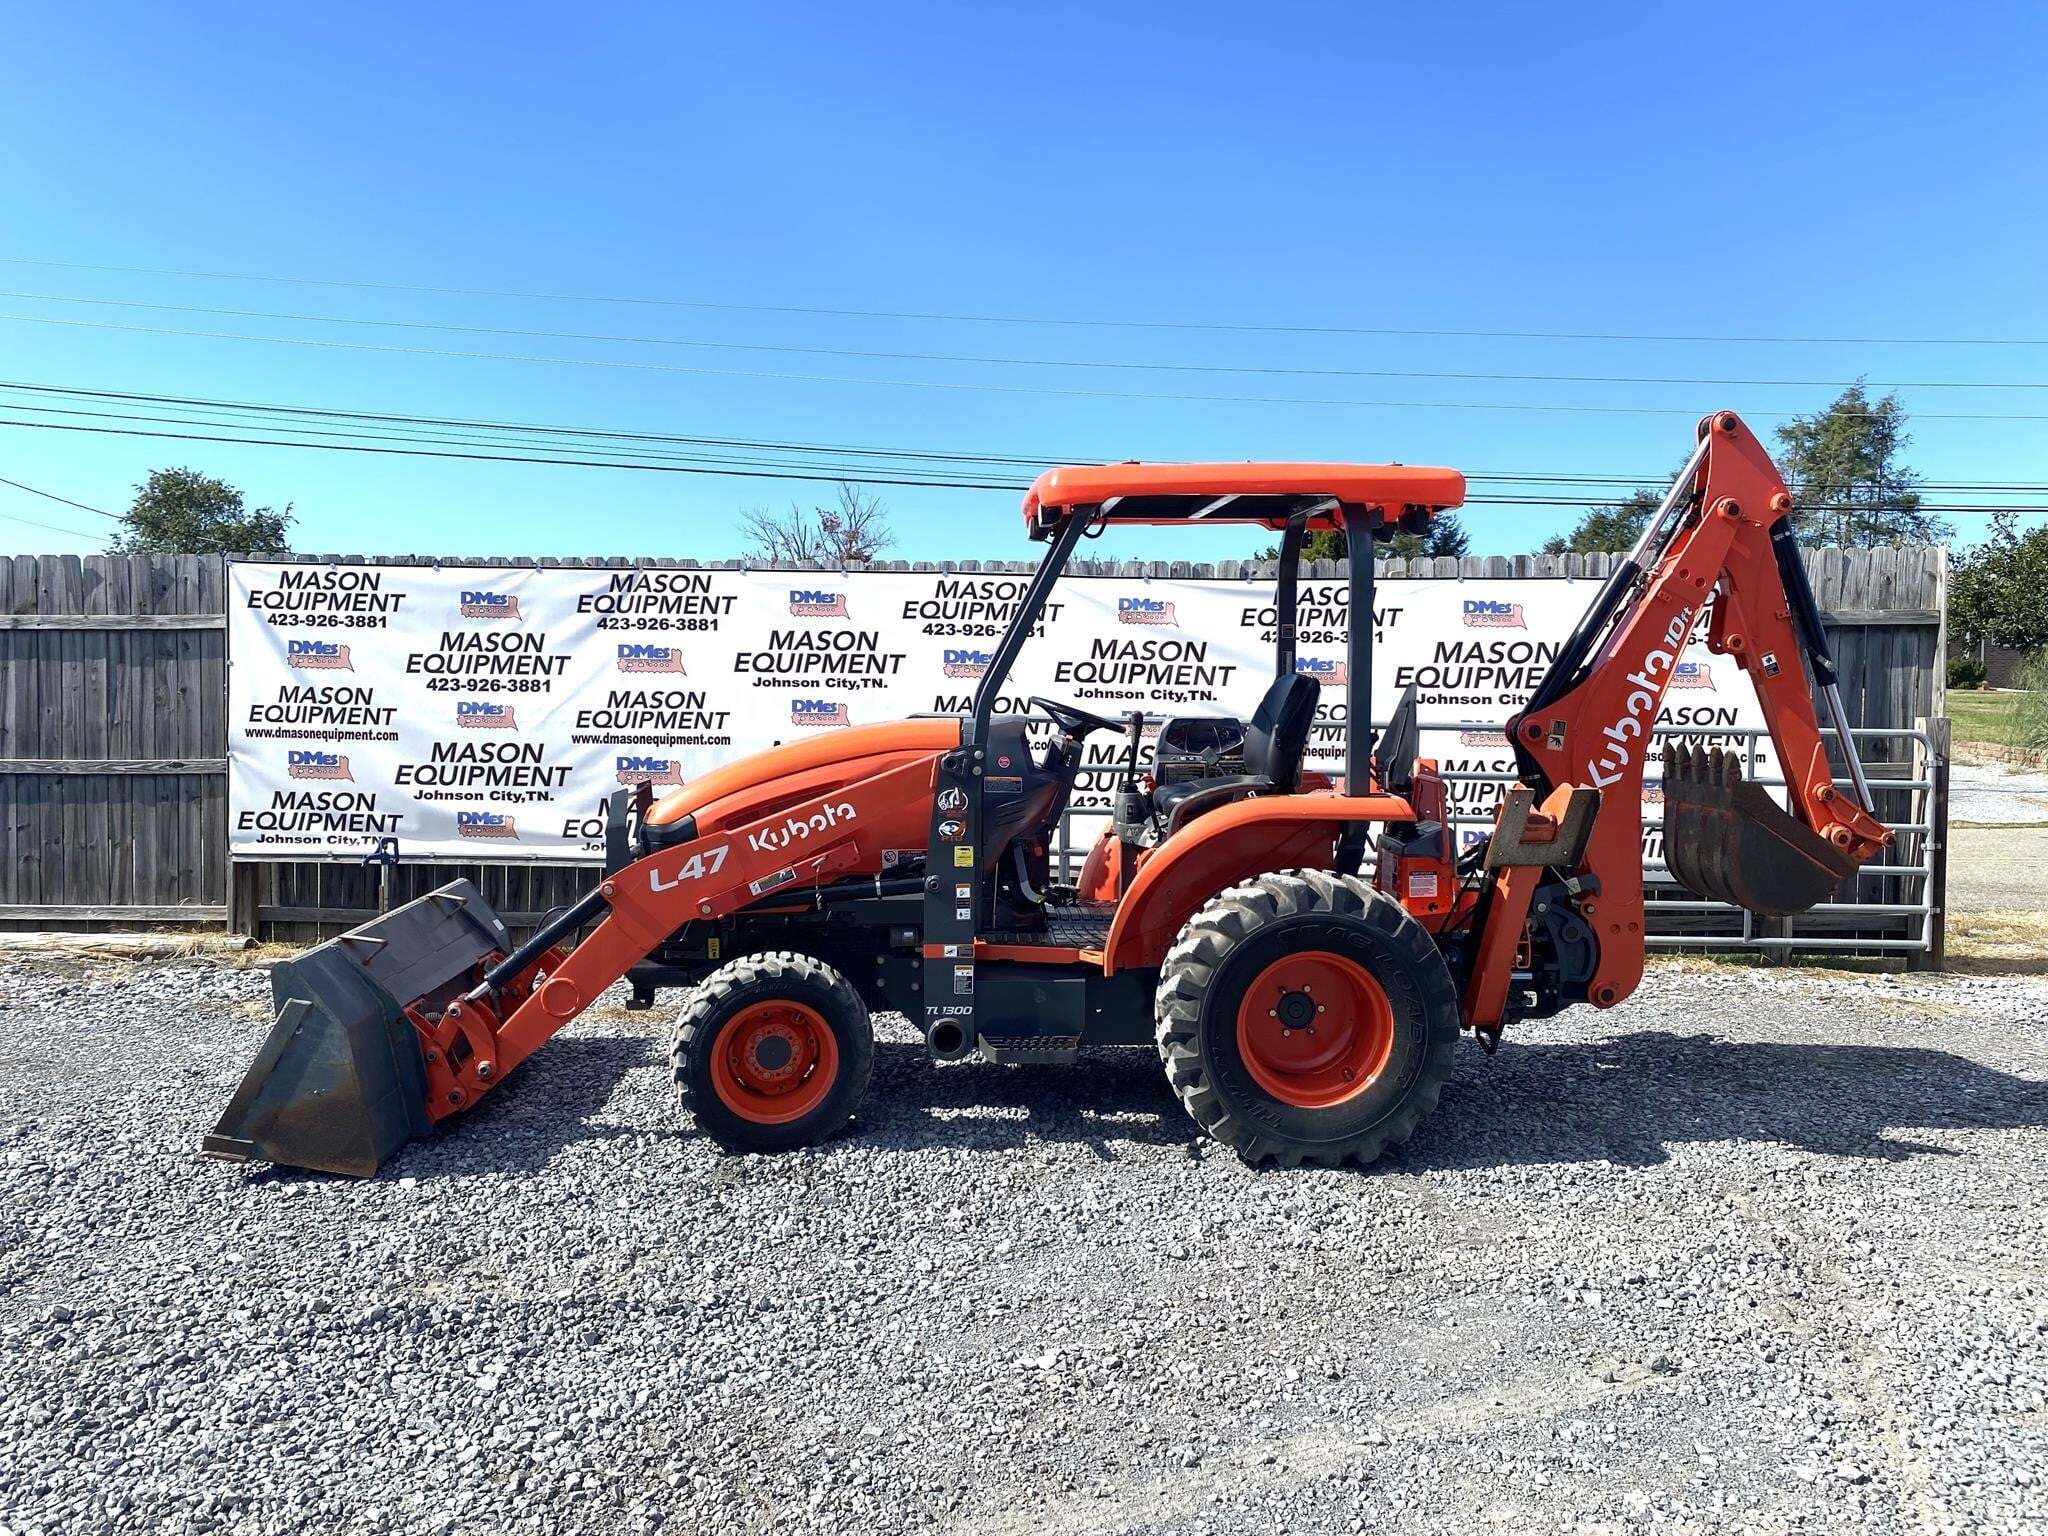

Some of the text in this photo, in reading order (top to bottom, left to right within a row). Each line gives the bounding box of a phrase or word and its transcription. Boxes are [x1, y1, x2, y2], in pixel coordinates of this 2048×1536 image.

[279, 571, 380, 590] MASON
[609, 574, 711, 593] MASON
[248, 591, 406, 612] EQUIPMENT
[577, 595, 737, 614] EQUIPMENT
[268, 614, 386, 628] 423-926-3881
[597, 617, 717, 631] 423-926-3881
[440, 632, 545, 652] MASON
[769, 631, 878, 651] MASON
[1091, 639, 1207, 662] MASON
[1434, 642, 1560, 664] MASON
[406, 654, 571, 675] EQUIPMENT
[734, 653, 906, 674] EQUIPMENT
[753, 677, 819, 687] Johnson
[1055, 662, 1236, 686] EQUIPMENT
[1394, 667, 1545, 688] EQUIPME
[427, 678, 550, 692] 423-926-3881
[1074, 688, 1144, 699] Johnson
[279, 686, 373, 705] MASON
[608, 691, 705, 709] MASON
[934, 696, 1031, 714] MAON
[1416, 693, 1492, 705] Johnson
[249, 705, 397, 725] EQUIPMENT
[576, 711, 730, 729] EQUIPMENT
[1579, 649, 1674, 789] Kubota
[1655, 707, 1738, 725] ASON
[245, 727, 398, 742] www.dmasonequipment.com
[572, 733, 730, 747] www.dmasonequipment.com
[431, 742, 544, 763] MASON
[395, 765, 573, 786] EQUIPMENT
[272, 791, 376, 811] MASON
[414, 790, 483, 800] Johnson
[238, 811, 403, 832] EQUIPMENT
[749, 802, 857, 852] Kubota
[256, 834, 321, 843] Johnson
[650, 846, 729, 893] L47
[925, 1006, 973, 1015] TL 1300
